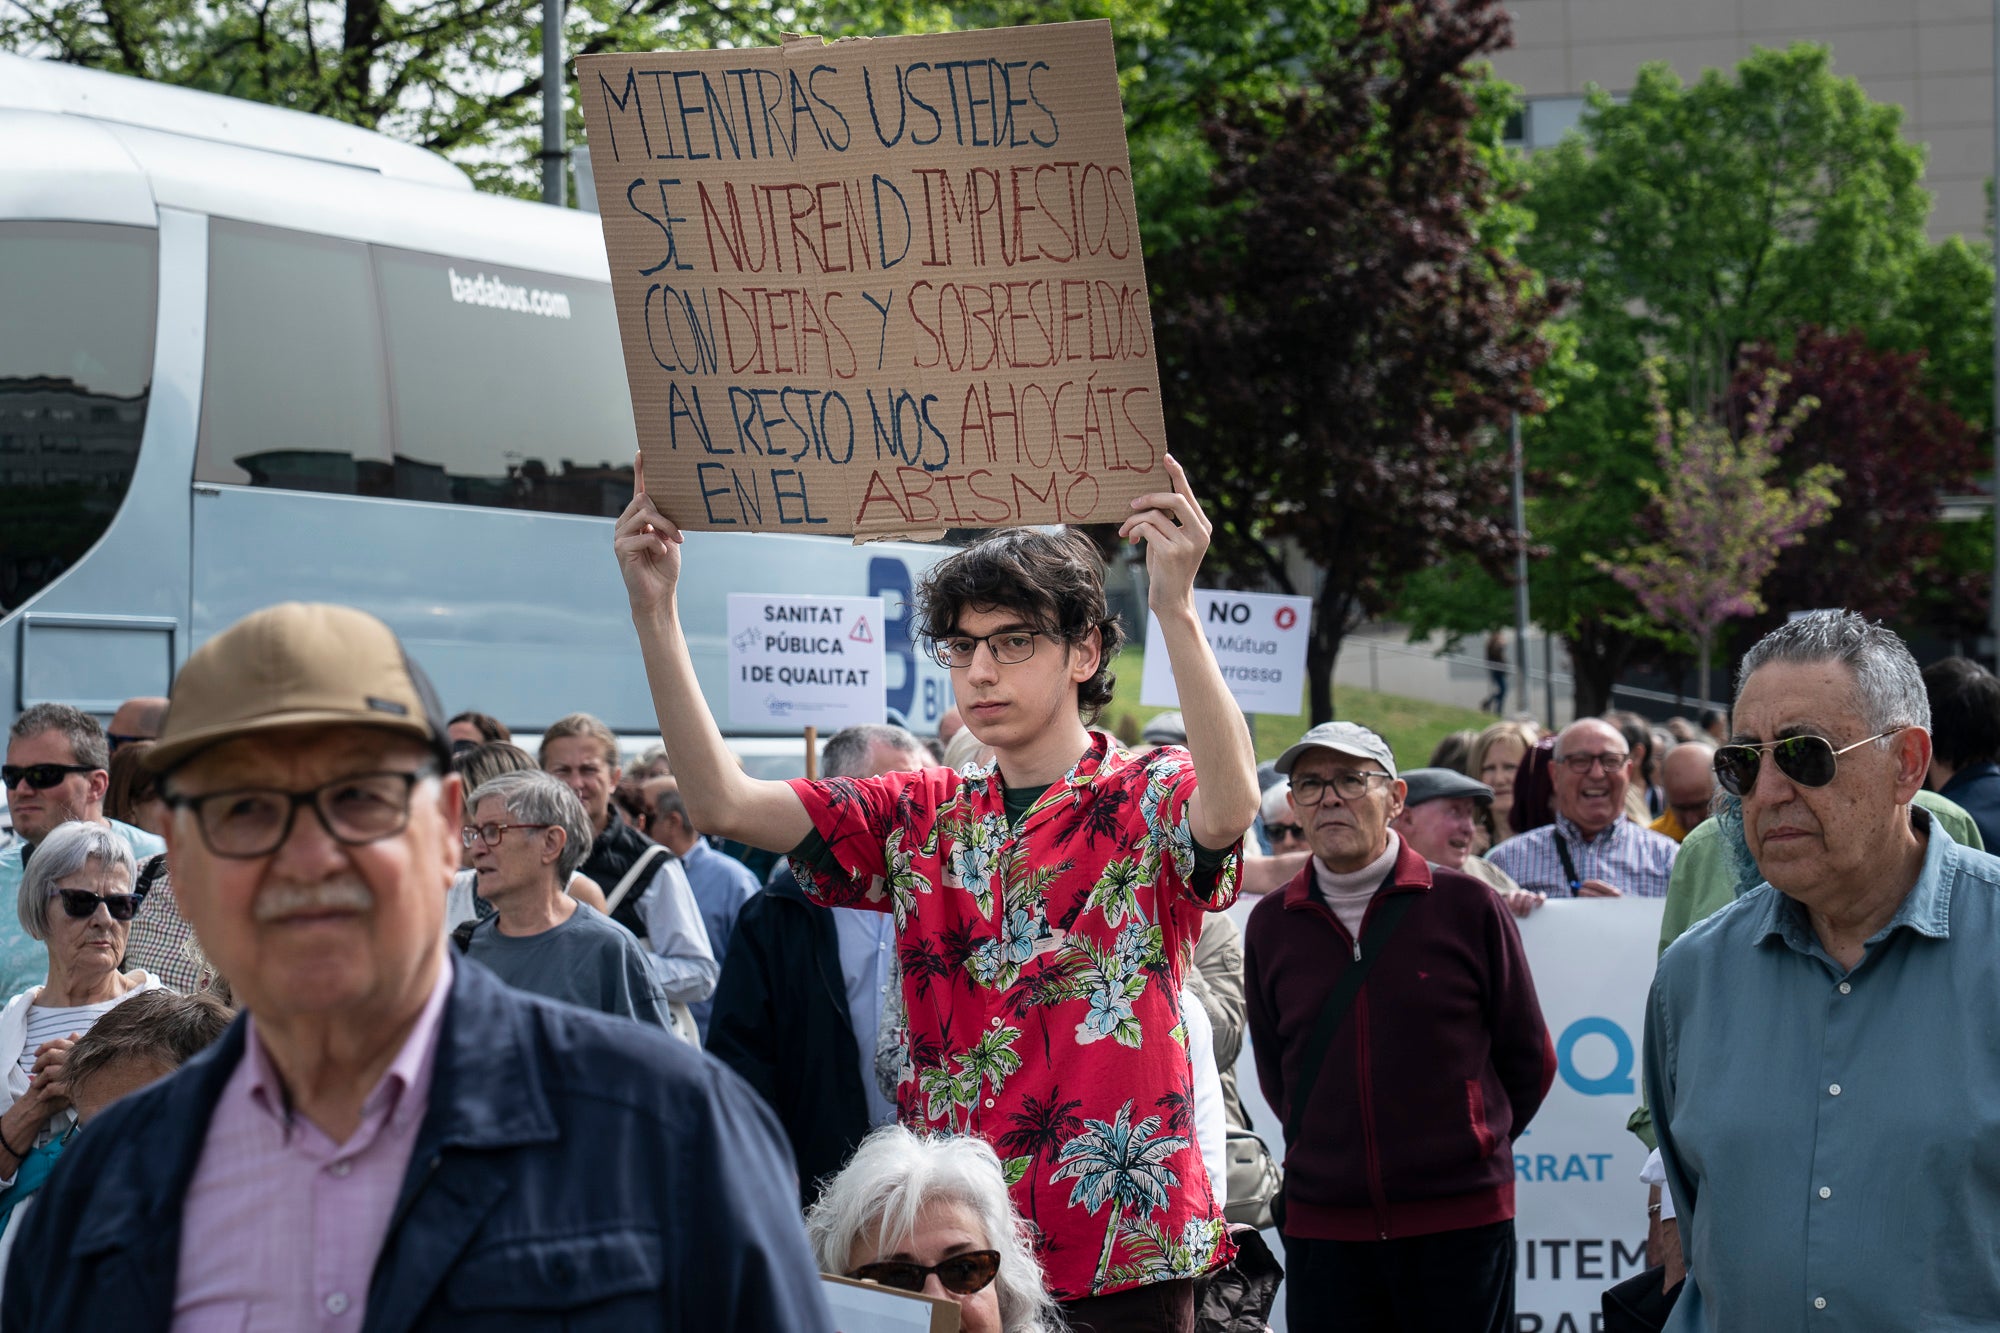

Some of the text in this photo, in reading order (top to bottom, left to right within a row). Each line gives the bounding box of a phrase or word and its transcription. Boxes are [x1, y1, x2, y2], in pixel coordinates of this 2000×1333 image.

[598, 57, 1059, 162] MIENTRAS USTEDES
[627, 178, 694, 277] SE
[696, 179, 872, 273] NUTREN
[912, 161, 1131, 267] IMPUESTOS
[449, 267, 571, 320] badabus.com
[645, 279, 1149, 378] CON DIETAS Y SOBRESUELDOS
[669, 370, 1155, 473] AL RESTO NOS AHOGÁIS
[697, 463, 1099, 526] EN EL ABISMO
[764, 604, 844, 625] SANITAT
[1209, 602, 1251, 624] NO
[765, 630, 844, 655] PÚBLICA
[1216, 634, 1278, 656] Mútua
[741, 666, 870, 687] I DE QUALITAT
[1219, 665, 1283, 684] rrassa
[1556, 1016, 1635, 1096] Q
[1515, 1239, 1650, 1280] ITEM
